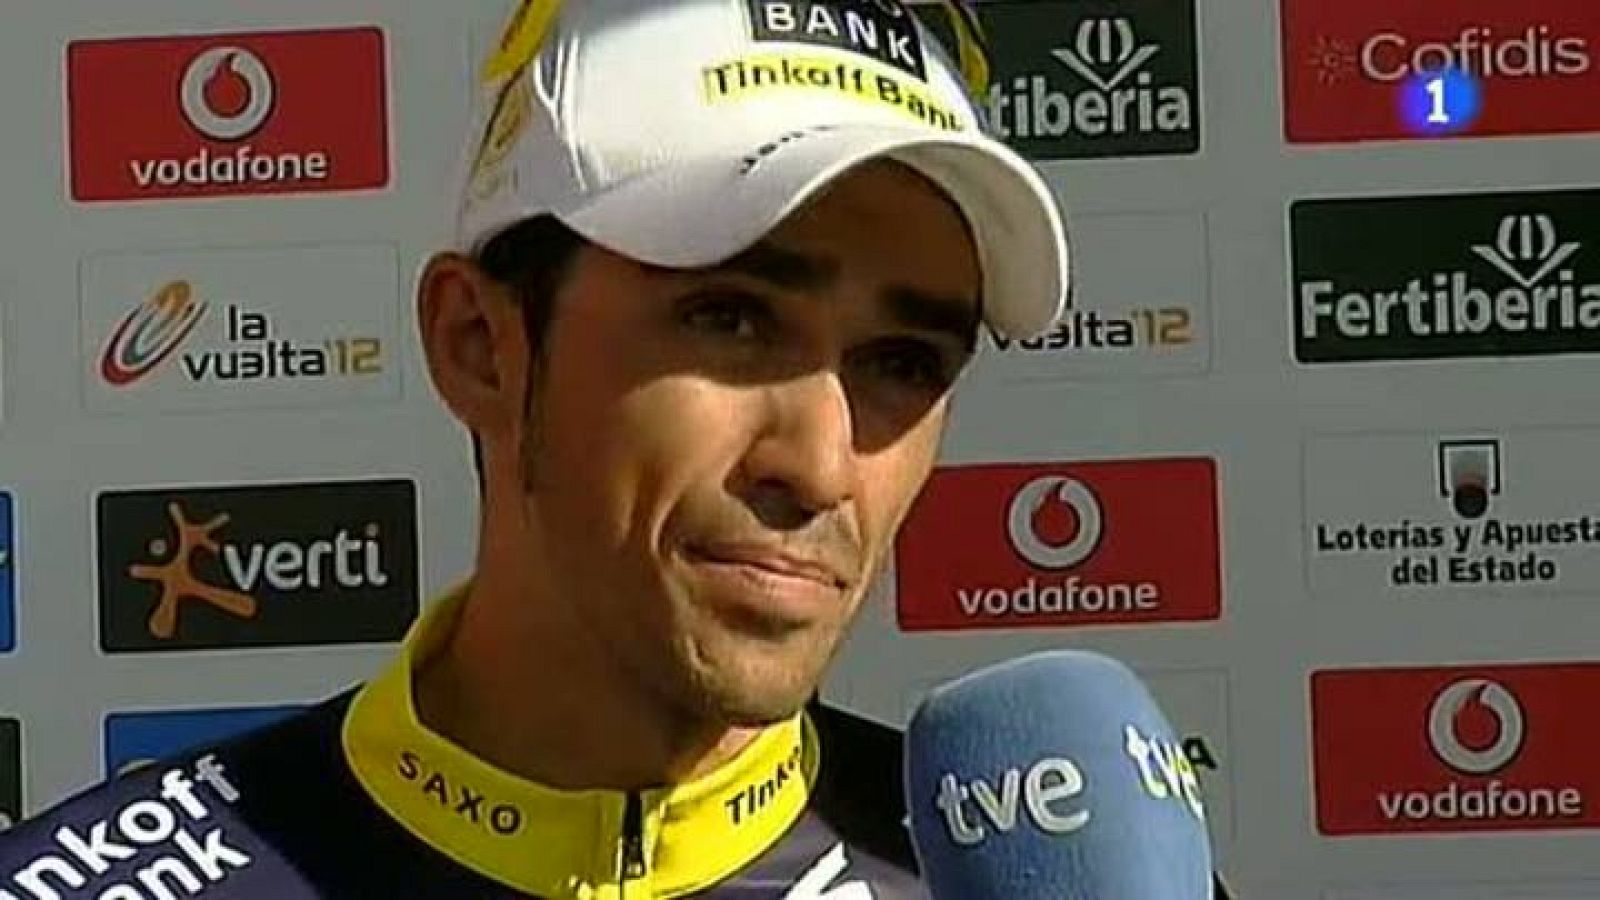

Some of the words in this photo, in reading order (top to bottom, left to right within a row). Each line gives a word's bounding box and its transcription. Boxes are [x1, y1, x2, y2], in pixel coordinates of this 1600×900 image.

[765, 2, 915, 66] BANK
[1361, 25, 1590, 82] Cofidis
[704, 58, 864, 96] Tinkoff
[130, 146, 328, 186] vodafone
[228, 304, 268, 341] la
[990, 308, 1192, 350] elta'12
[1301, 270, 1600, 339] Fertiberia
[224, 523, 389, 591] verti
[1454, 525, 1471, 551] y
[1392, 556, 1438, 584] del
[1450, 552, 1556, 583] Estado
[958, 577, 1159, 616] vodafone
[397, 750, 523, 836] SAXO
[725, 746, 800, 825] Tink
[936, 756, 1091, 846] tve
[1378, 780, 1582, 821] vodafone
[0, 754, 240, 900] nkoff
